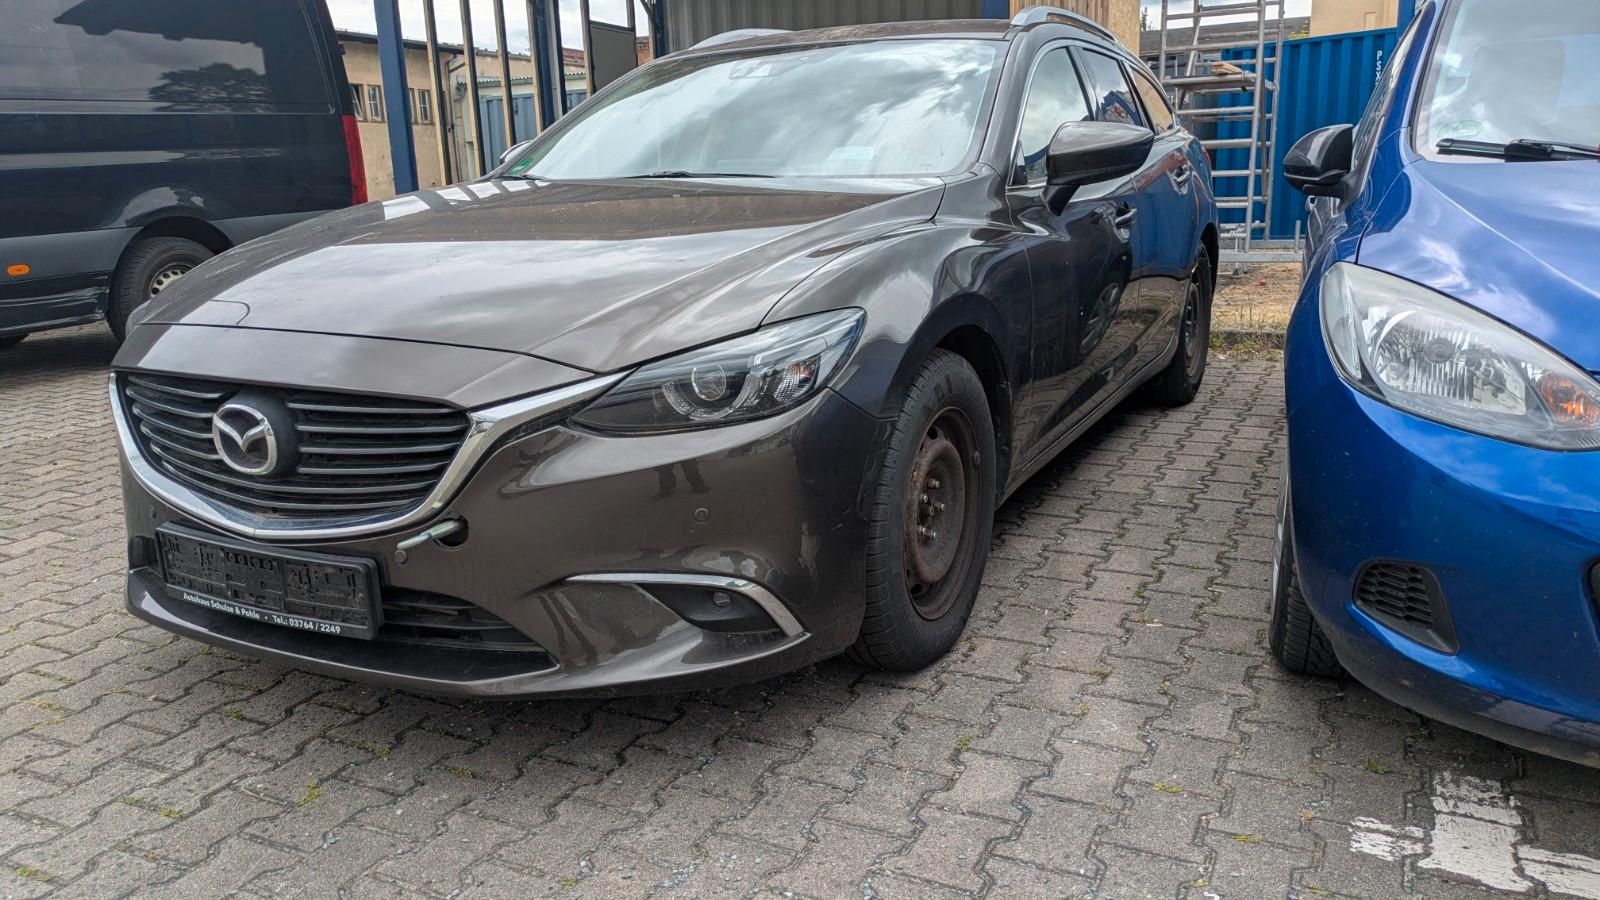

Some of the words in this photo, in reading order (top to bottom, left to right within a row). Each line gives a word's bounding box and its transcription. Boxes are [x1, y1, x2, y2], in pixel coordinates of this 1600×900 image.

[183, 592, 210, 607] Autohaus
[210, 600, 234, 613] Schulze
[235, 606, 241, 615] &
[240, 608, 260, 620] Pohle
[272, 614, 288, 625] Tel.:
[289, 618, 314, 629] 03764
[320, 623, 341, 634] 2249
